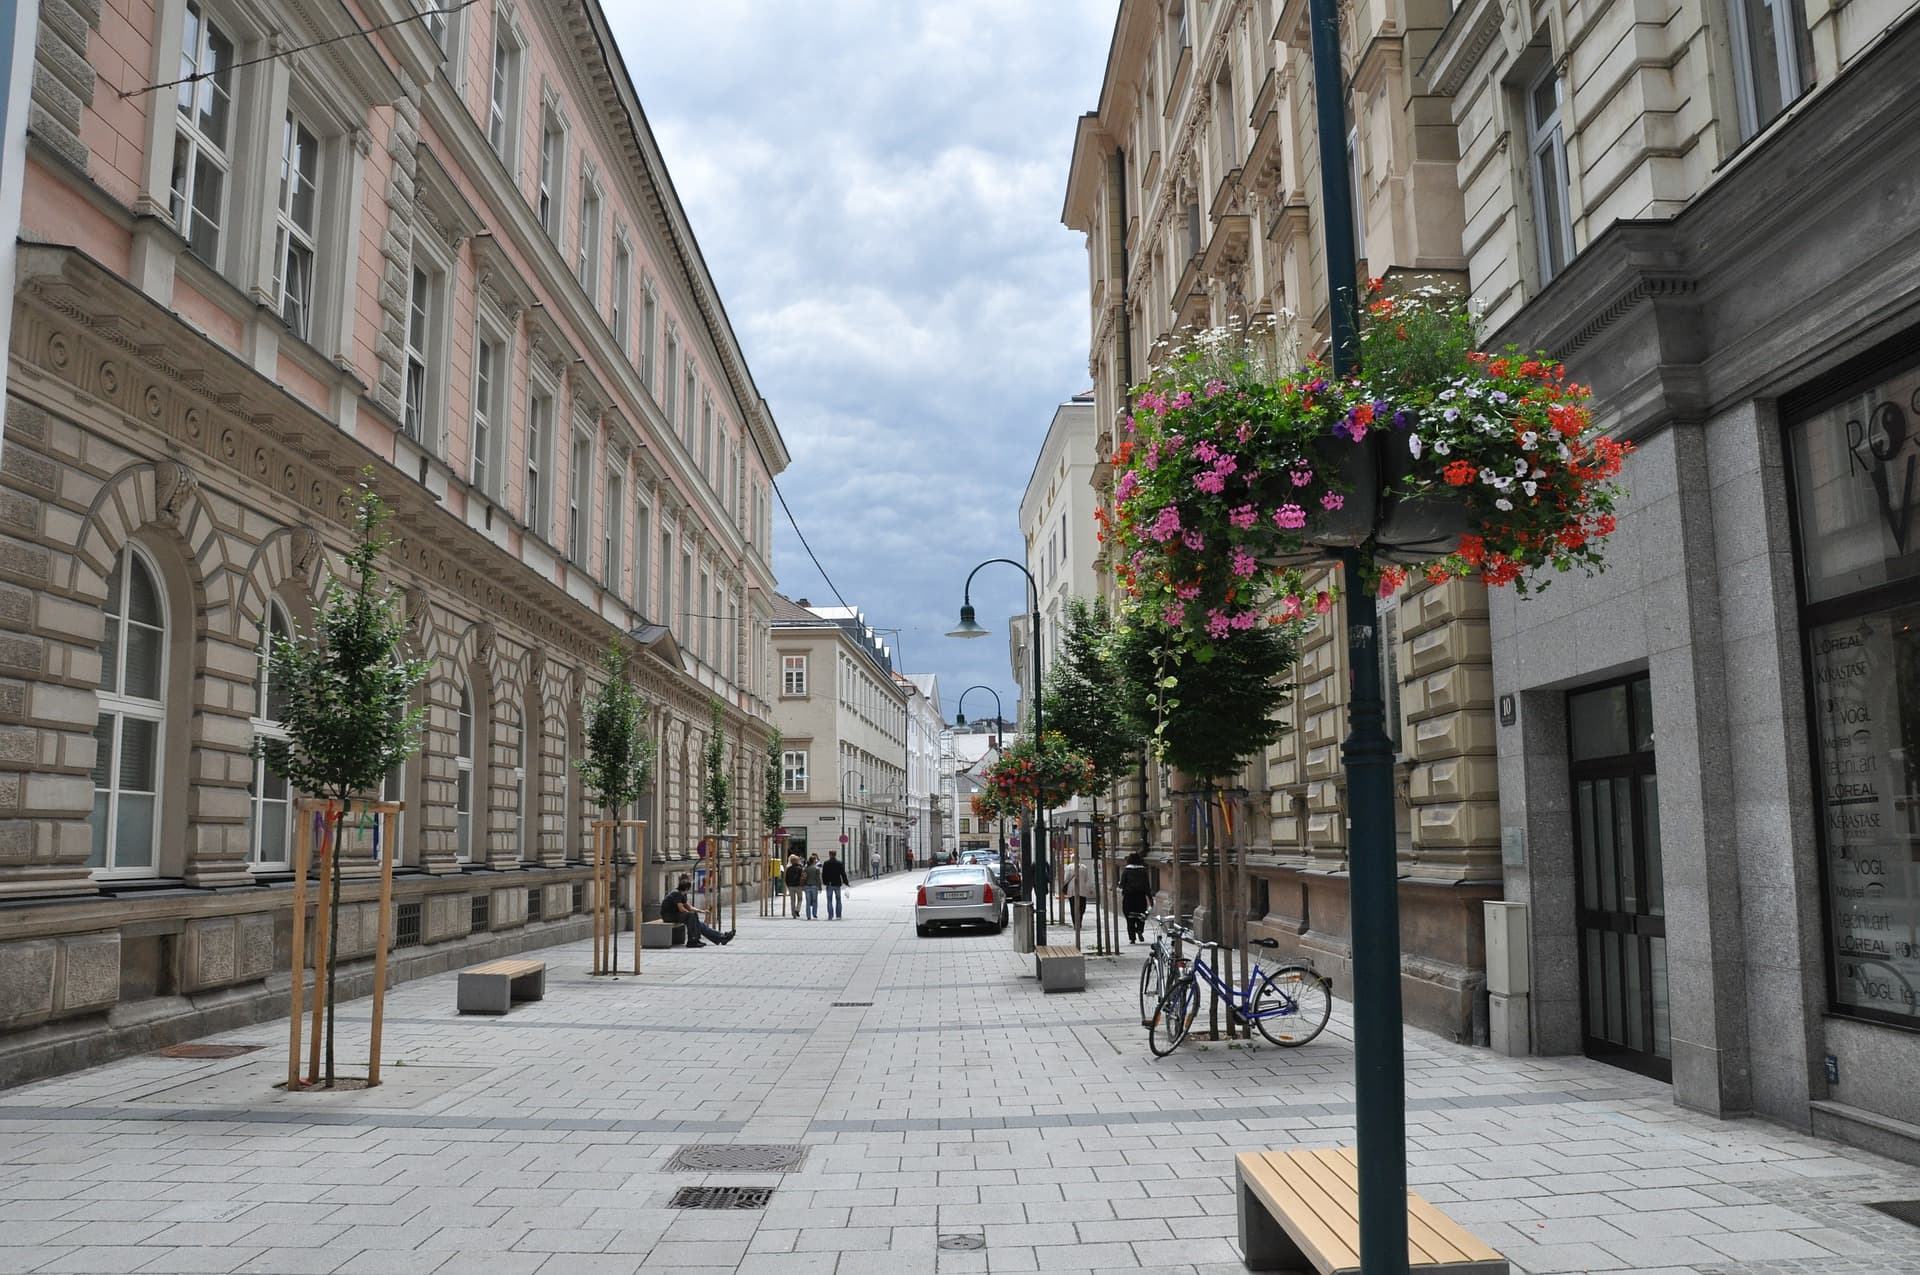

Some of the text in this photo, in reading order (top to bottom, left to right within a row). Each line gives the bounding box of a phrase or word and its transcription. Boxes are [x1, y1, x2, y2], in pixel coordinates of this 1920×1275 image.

[1503, 698, 1511, 716] 10
[1840, 706, 1872, 724] VOGL
[1853, 857, 1887, 875] VOGL
[1861, 979, 1894, 1001] VOGL
